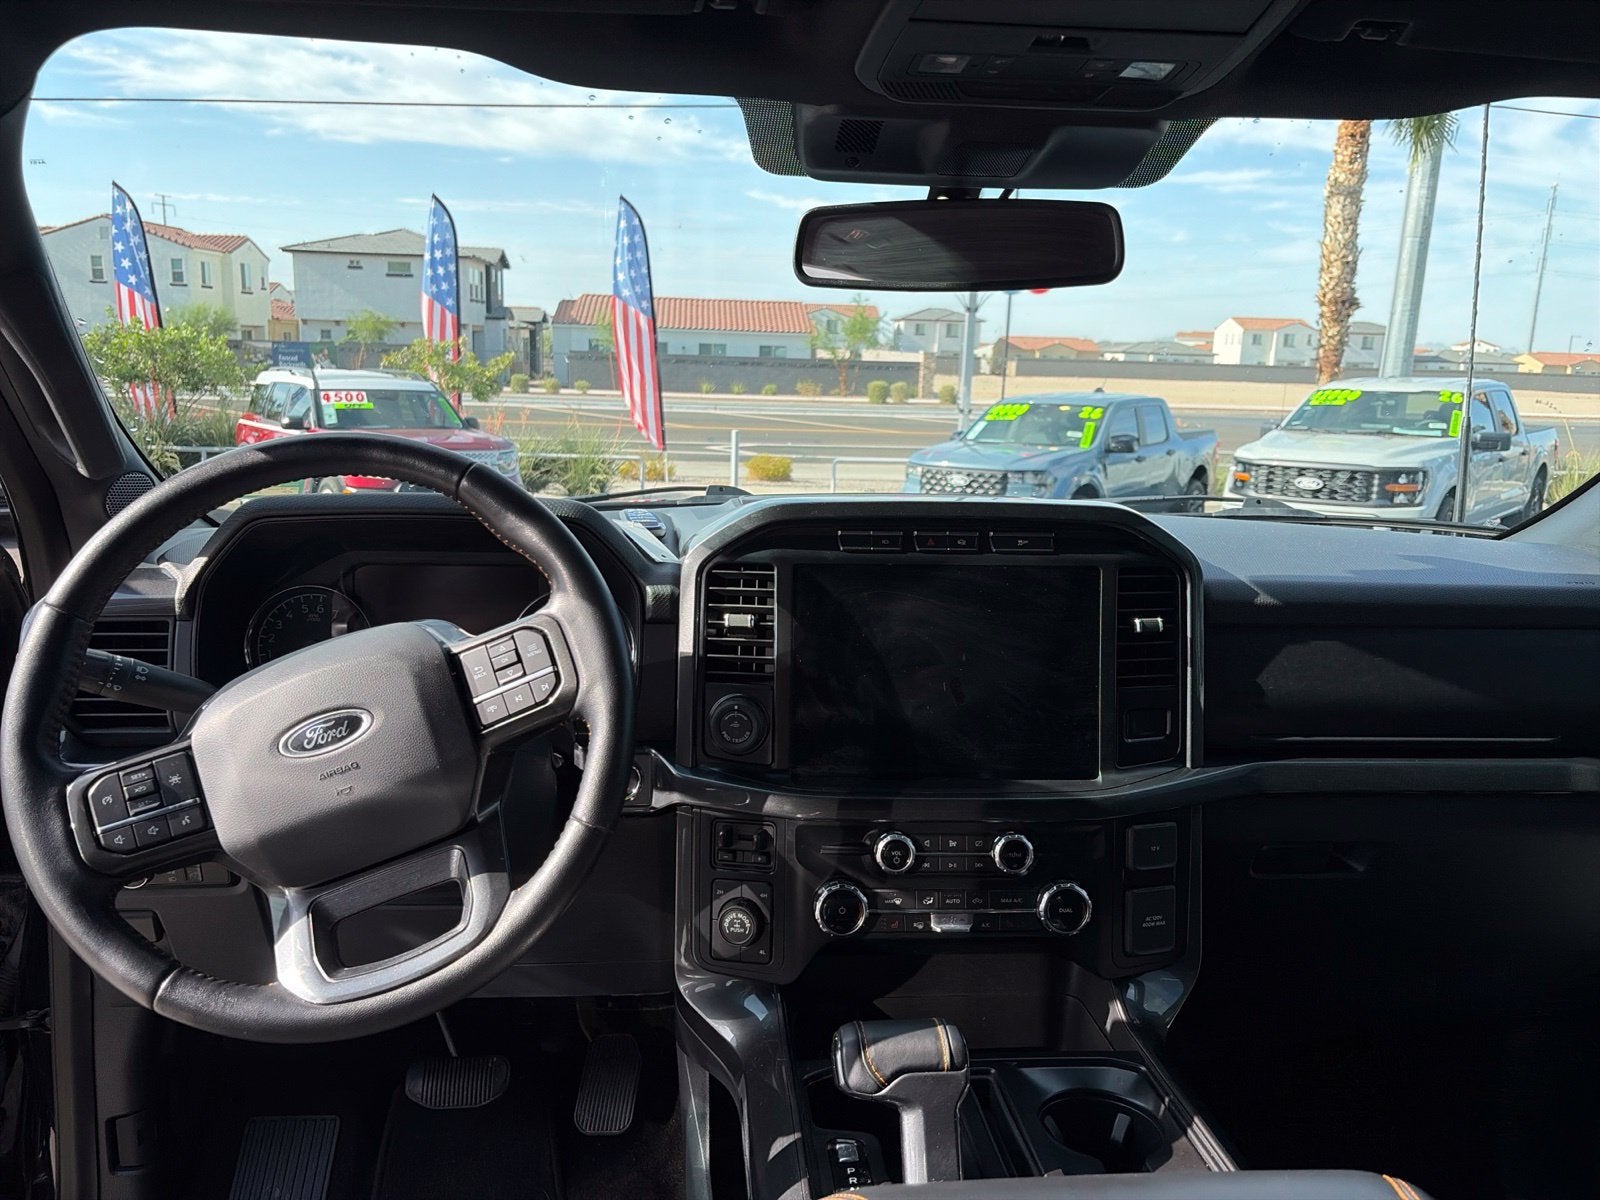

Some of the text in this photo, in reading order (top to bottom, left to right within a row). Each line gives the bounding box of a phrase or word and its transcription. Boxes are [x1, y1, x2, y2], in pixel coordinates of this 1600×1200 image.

[1439, 391, 1463, 404] 26
[304, 720, 349, 749] Ford
[319, 761, 361, 780] AIRBAG
[724, 912, 751, 927] DRIVE MODE
